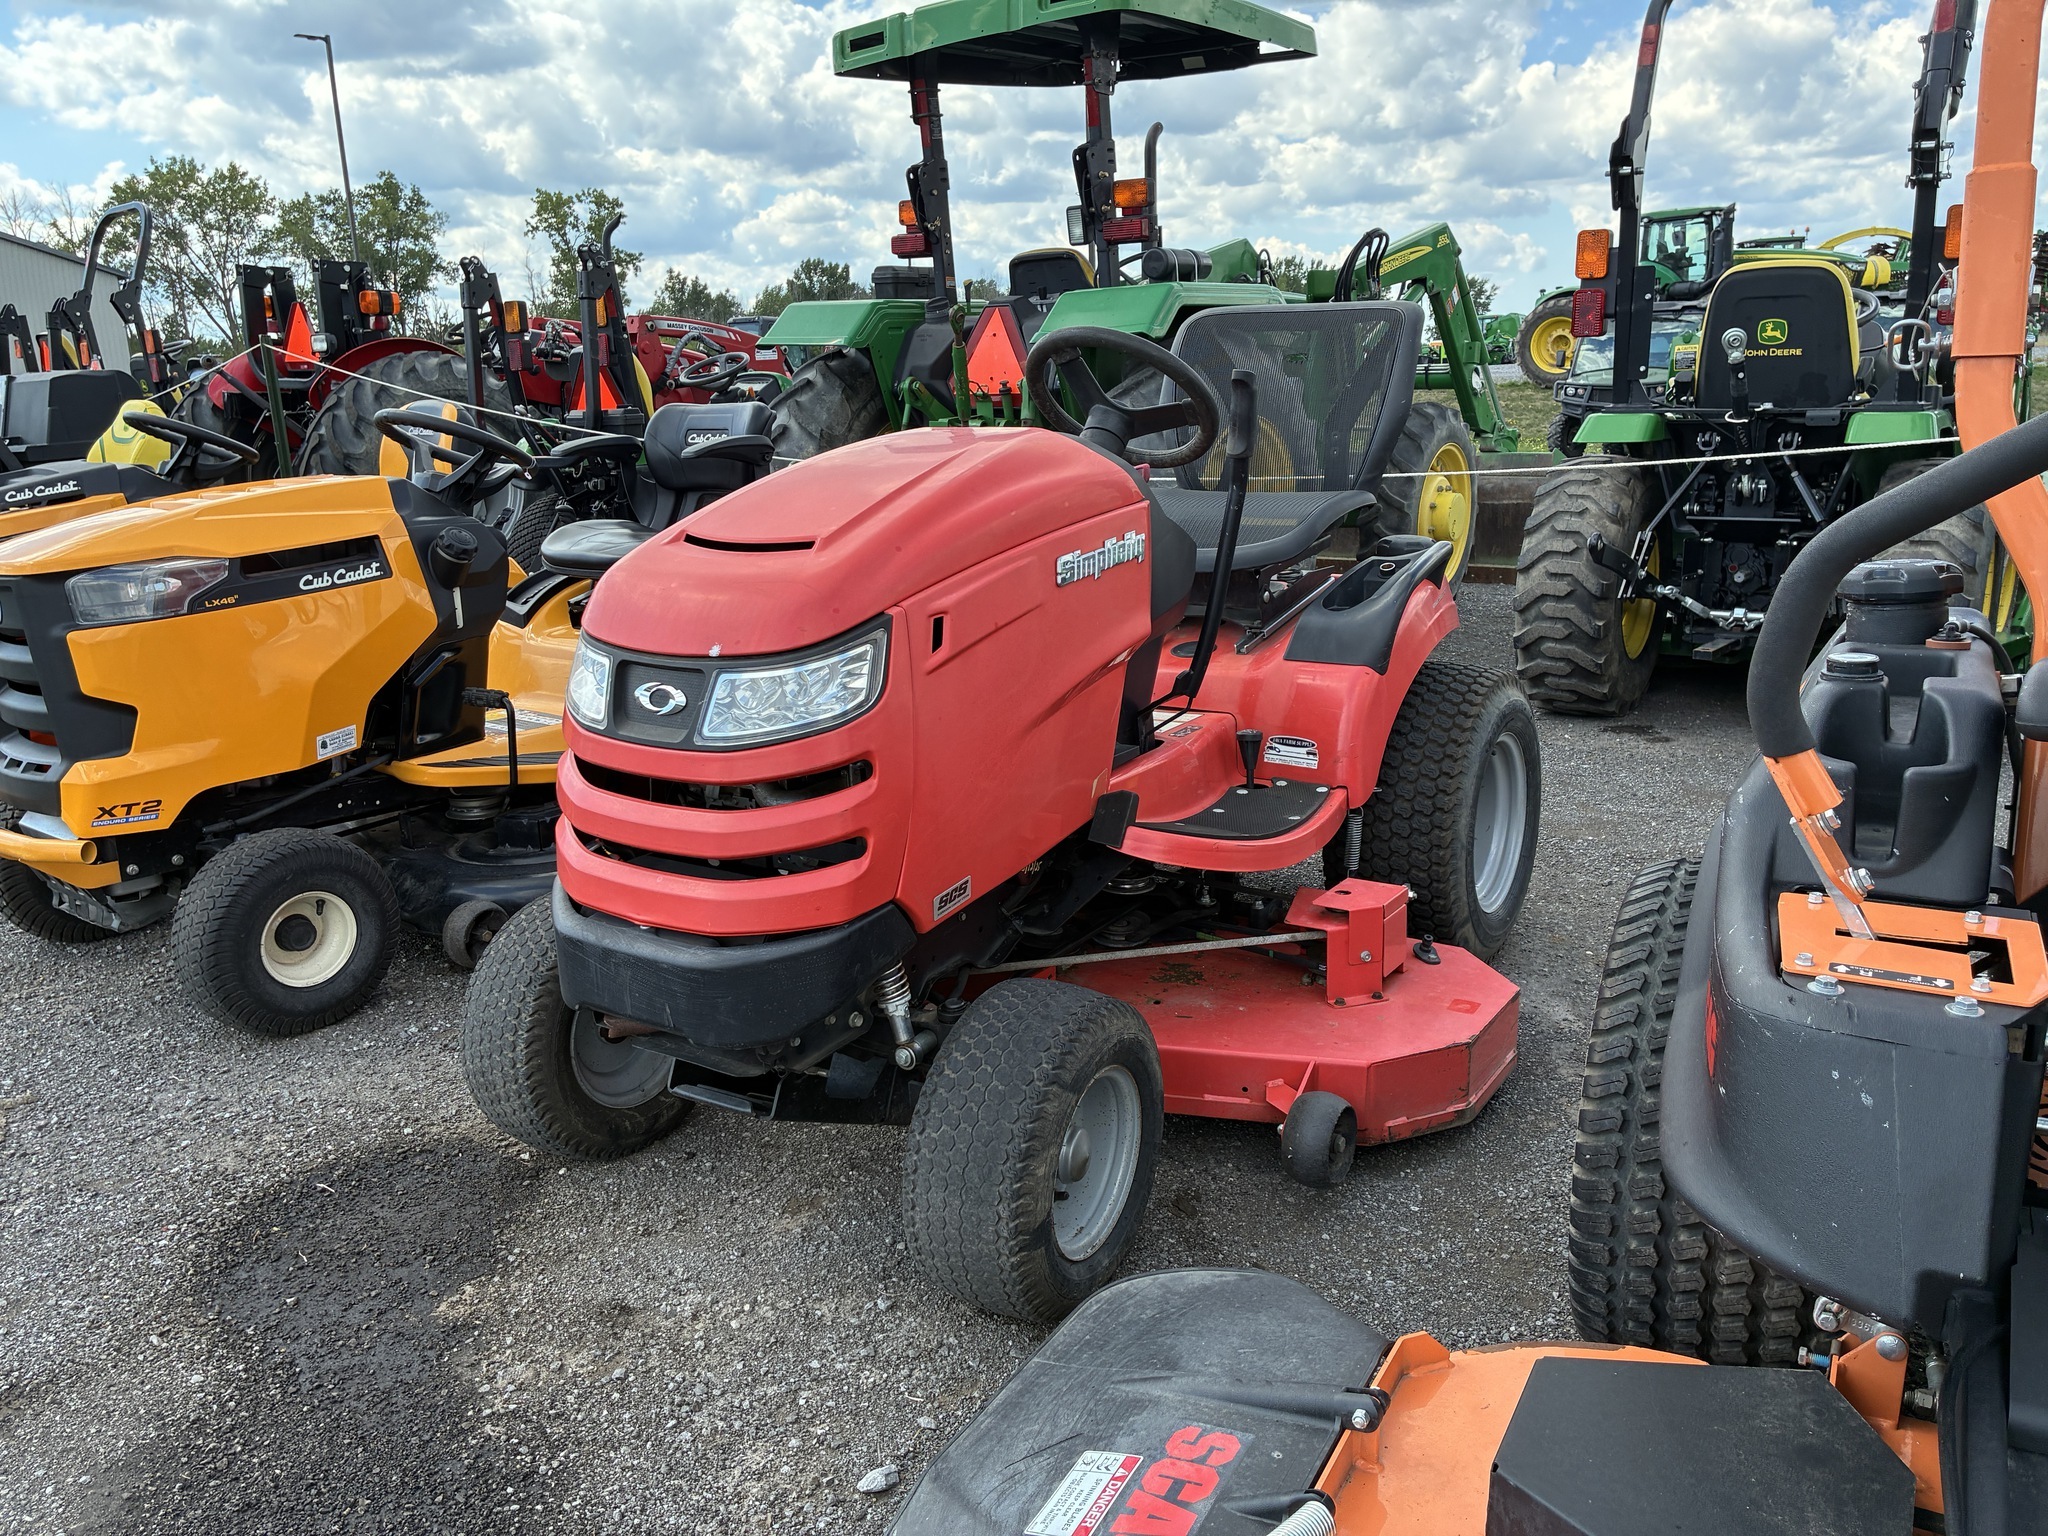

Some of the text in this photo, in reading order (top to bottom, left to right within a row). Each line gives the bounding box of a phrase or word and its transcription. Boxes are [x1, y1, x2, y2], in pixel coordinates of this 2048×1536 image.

[667, 322, 714, 334] MASSEY FERGUSON
[1743, 348, 1802, 357] JOHN DEERE
[688, 433, 704, 443] Cub
[4, 480, 78, 502] Cub Cadet
[1057, 530, 1145, 587] Simplicity
[299, 561, 381, 591] Cub Cadet
[92, 814, 156, 827] ENDURO SERIES
[93, 799, 163, 820] XT2
[938, 879, 970, 911] SCS
[1109, 1426, 1242, 1536] SCA
[1061, 1478, 1103, 1532] SPINNING BLADES
[1081, 1480, 1122, 1527] DANGER
